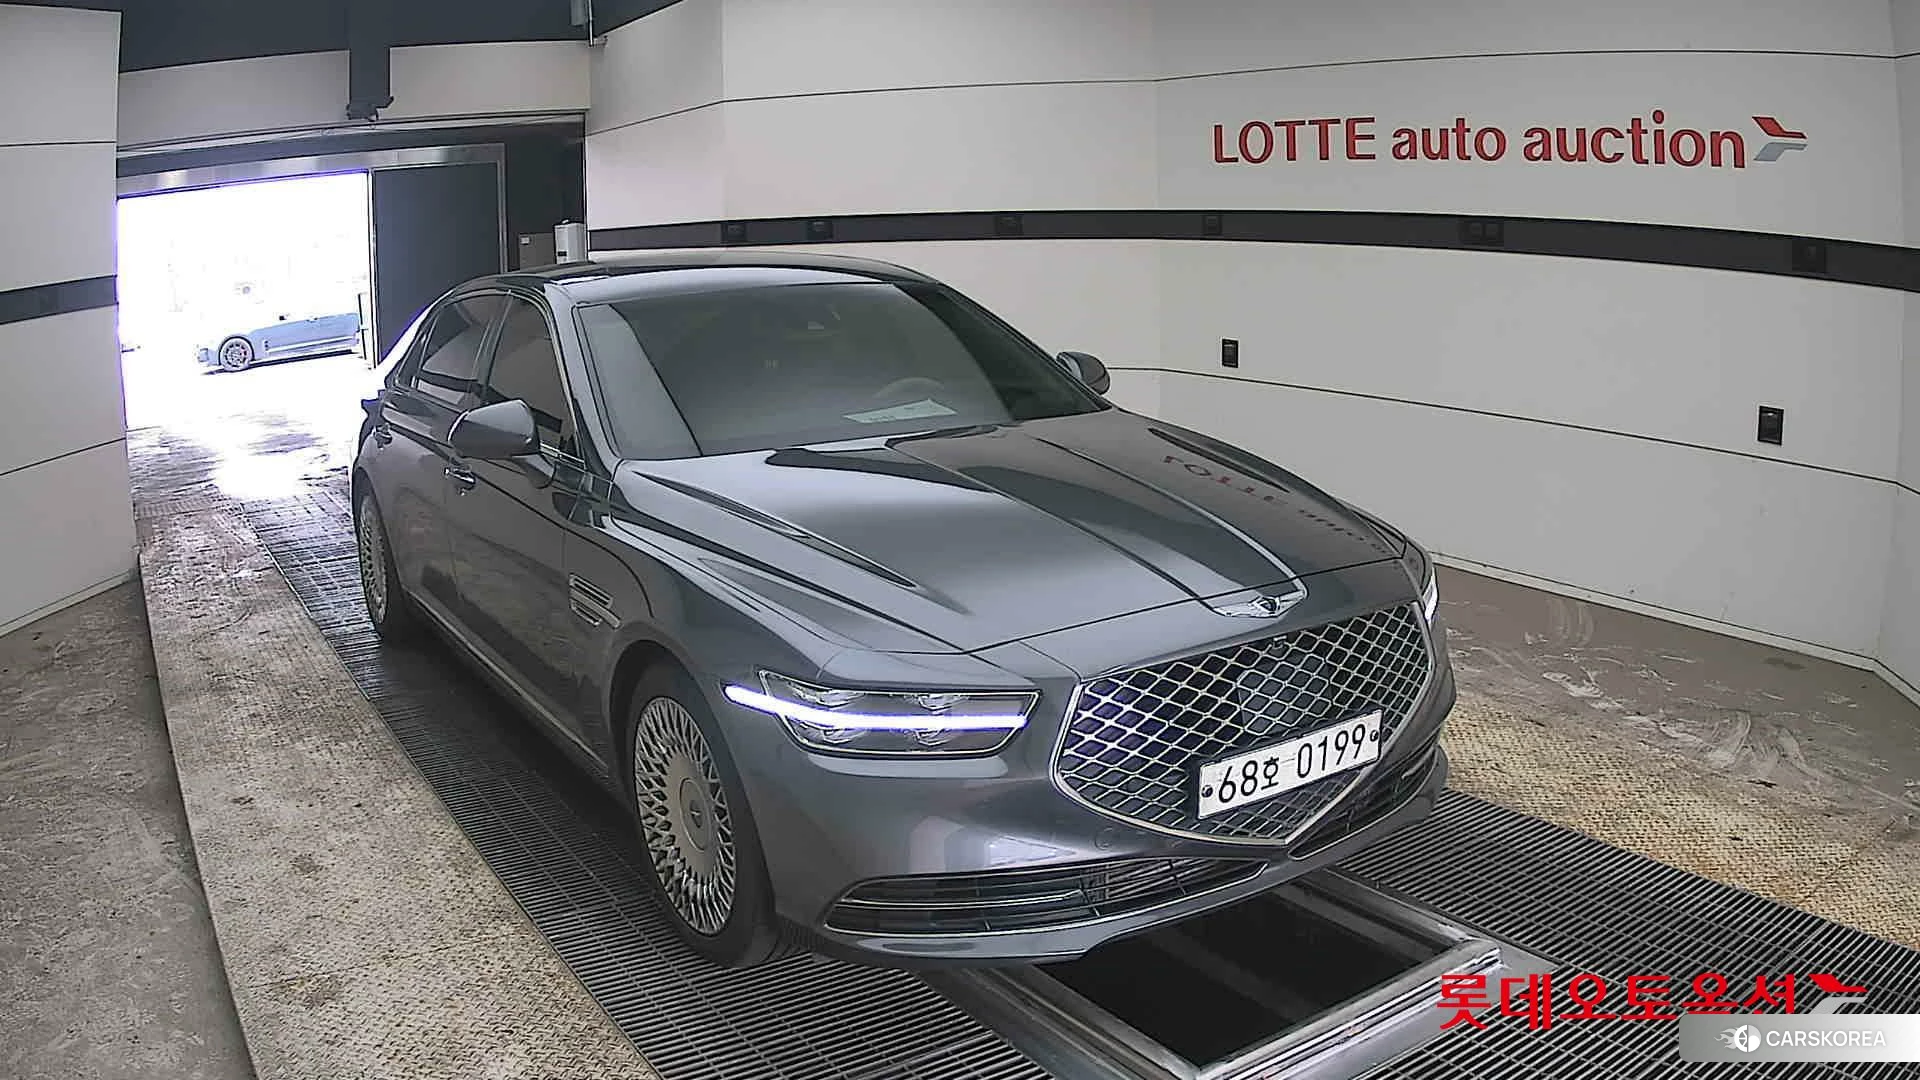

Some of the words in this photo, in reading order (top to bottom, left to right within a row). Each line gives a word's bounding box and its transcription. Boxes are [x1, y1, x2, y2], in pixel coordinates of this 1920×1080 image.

[1212, 116, 1376, 163] LOTTE
[1391, 117, 1507, 162] auto
[1523, 110, 1746, 169] auction
[1217, 756, 1280, 804] 68호
[1297, 723, 1366, 779] 0199
